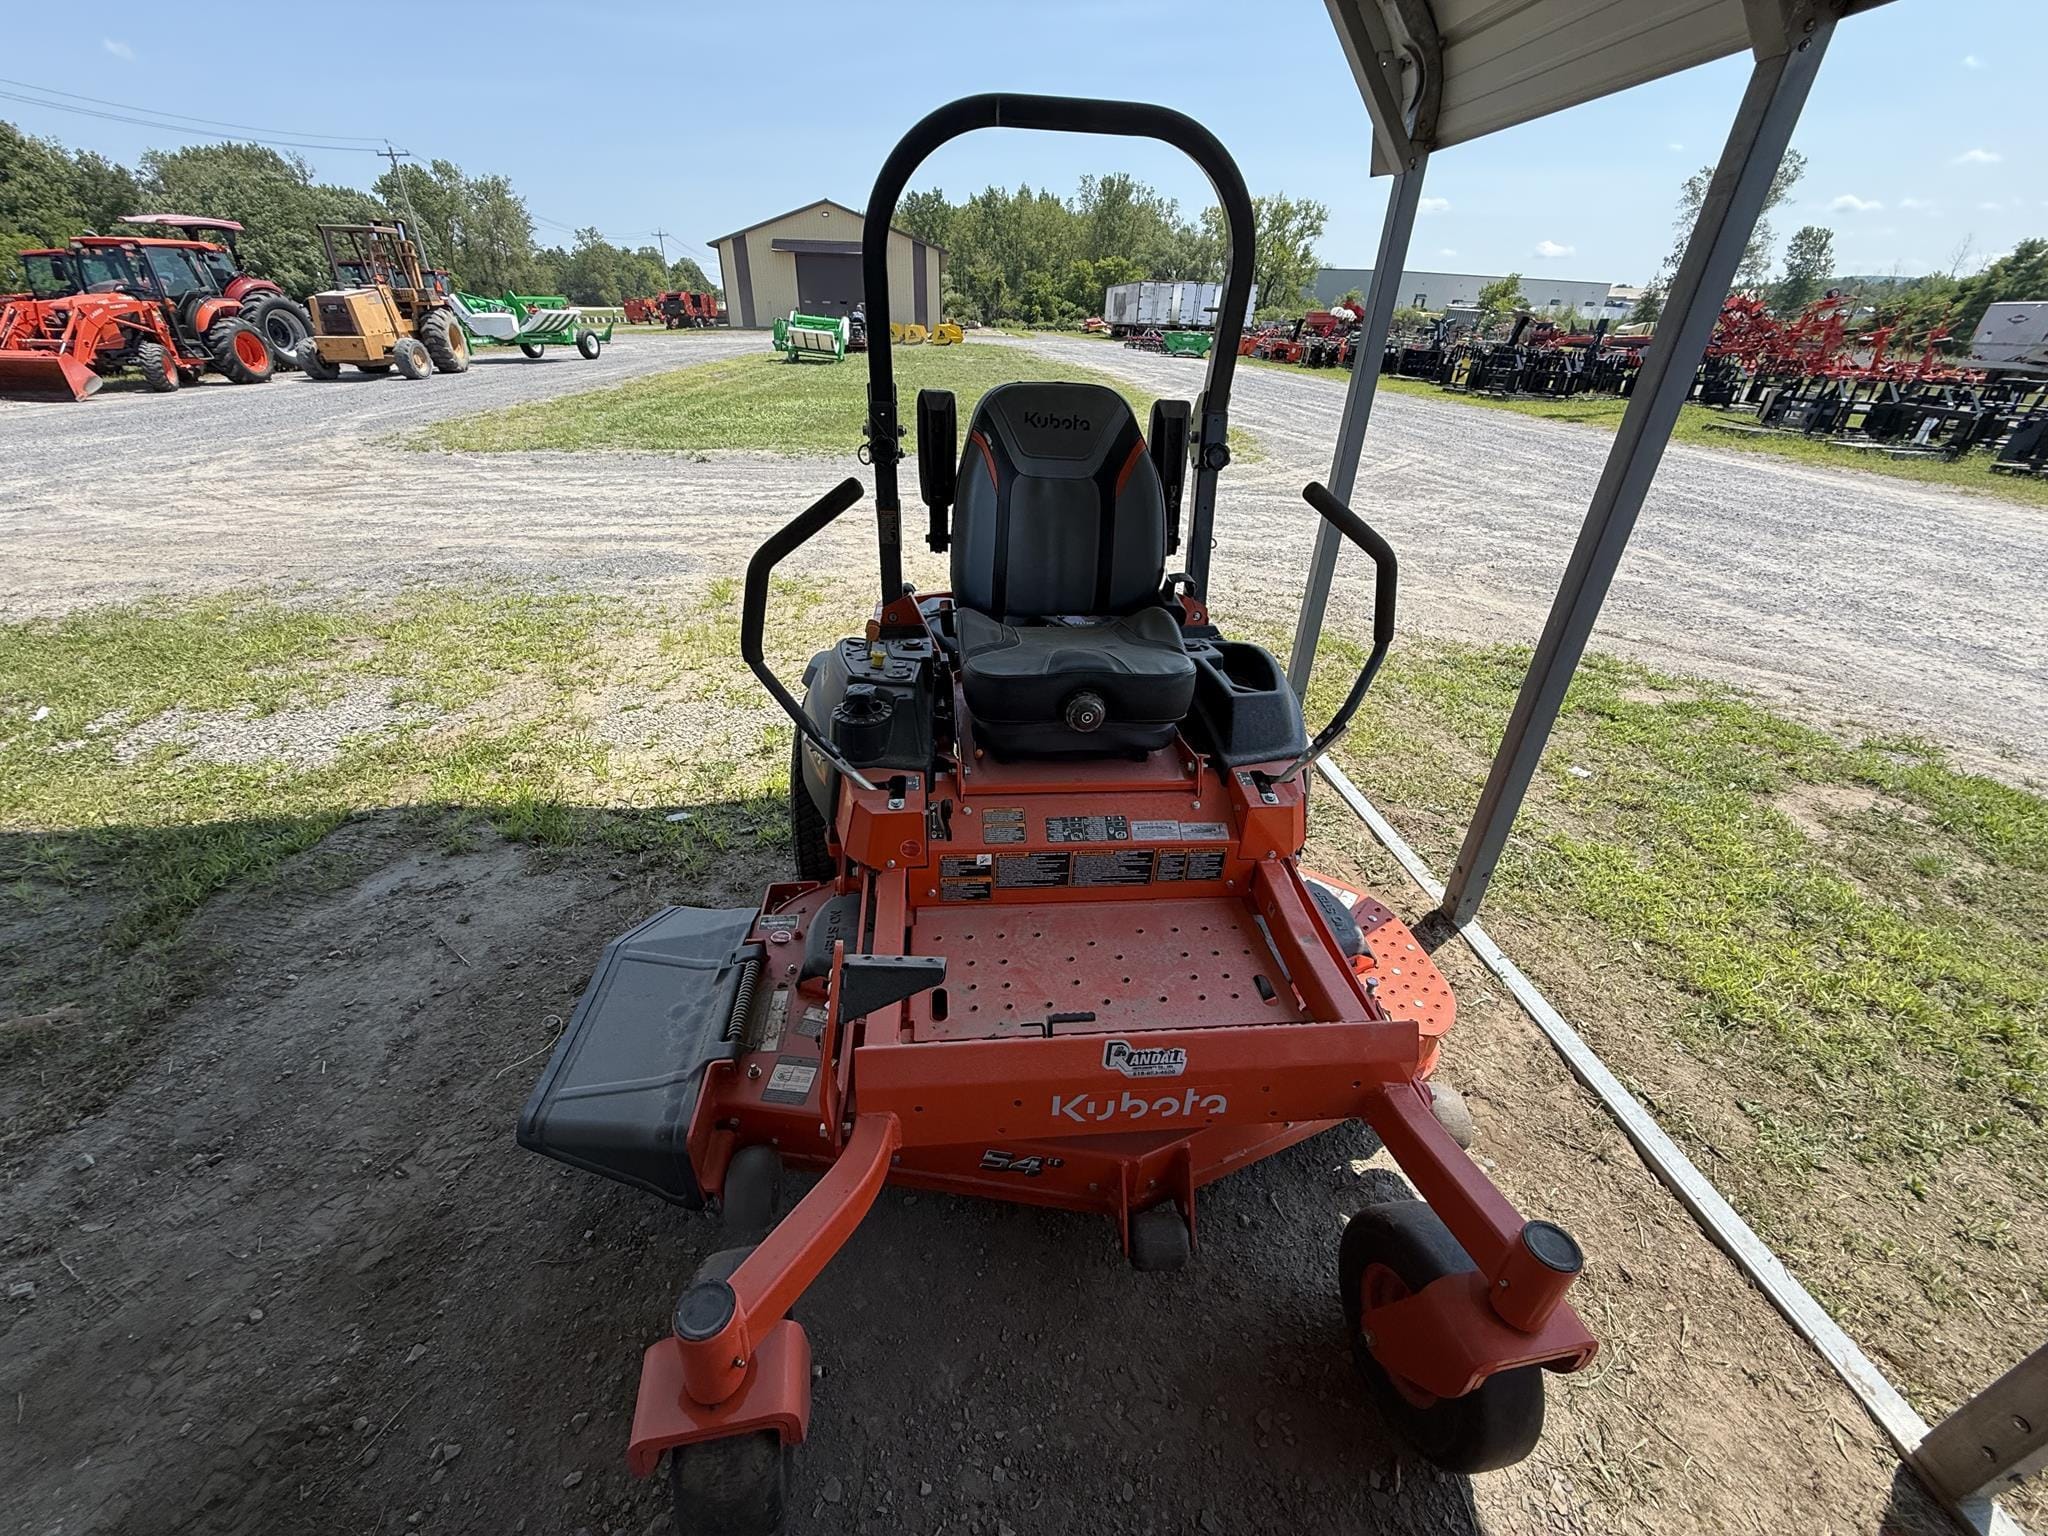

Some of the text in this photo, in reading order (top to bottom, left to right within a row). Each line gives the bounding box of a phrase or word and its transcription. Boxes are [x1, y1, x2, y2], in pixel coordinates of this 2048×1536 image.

[1024, 411, 1090, 431] Kubota
[1105, 1041, 1185, 1070] RANDALL
[1052, 1088, 1227, 1122] Kubota
